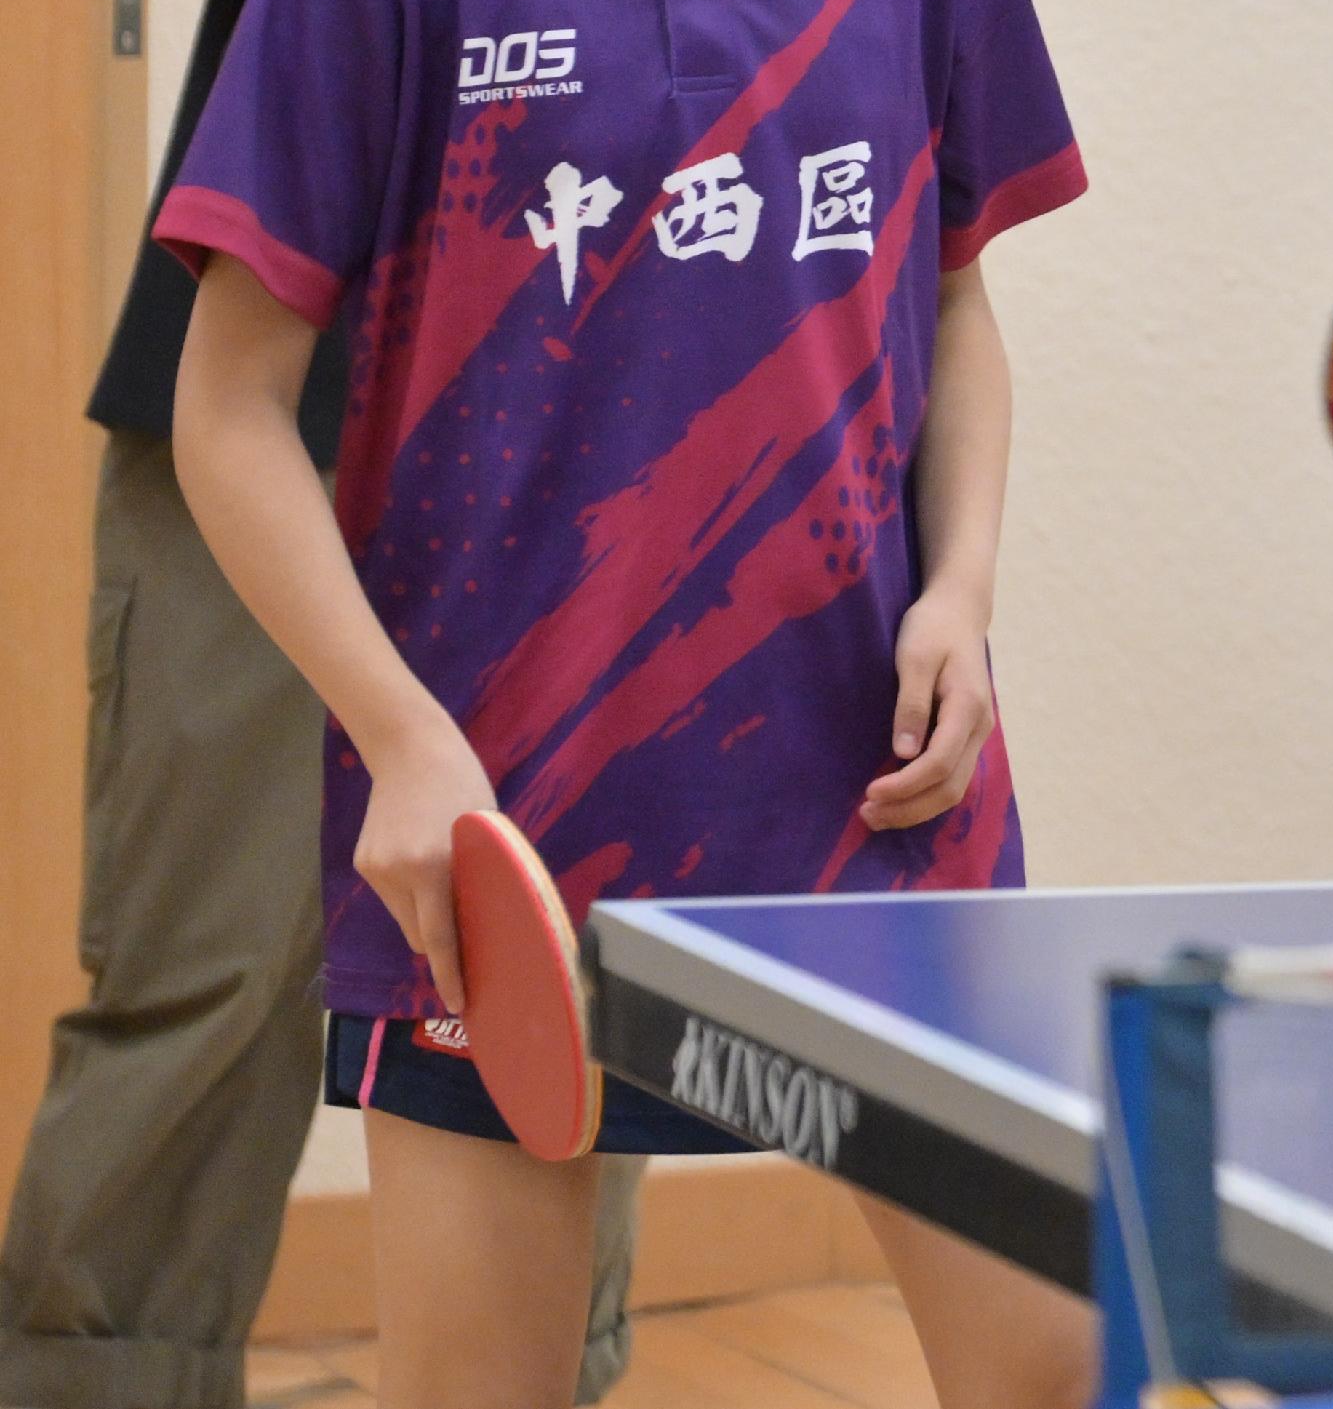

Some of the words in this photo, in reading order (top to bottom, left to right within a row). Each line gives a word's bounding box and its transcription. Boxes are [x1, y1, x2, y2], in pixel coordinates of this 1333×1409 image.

[458, 29, 576, 87] DOS
[458, 81, 583, 104] SPORTSWEAR
[524, 141, 873, 306] 中西區
